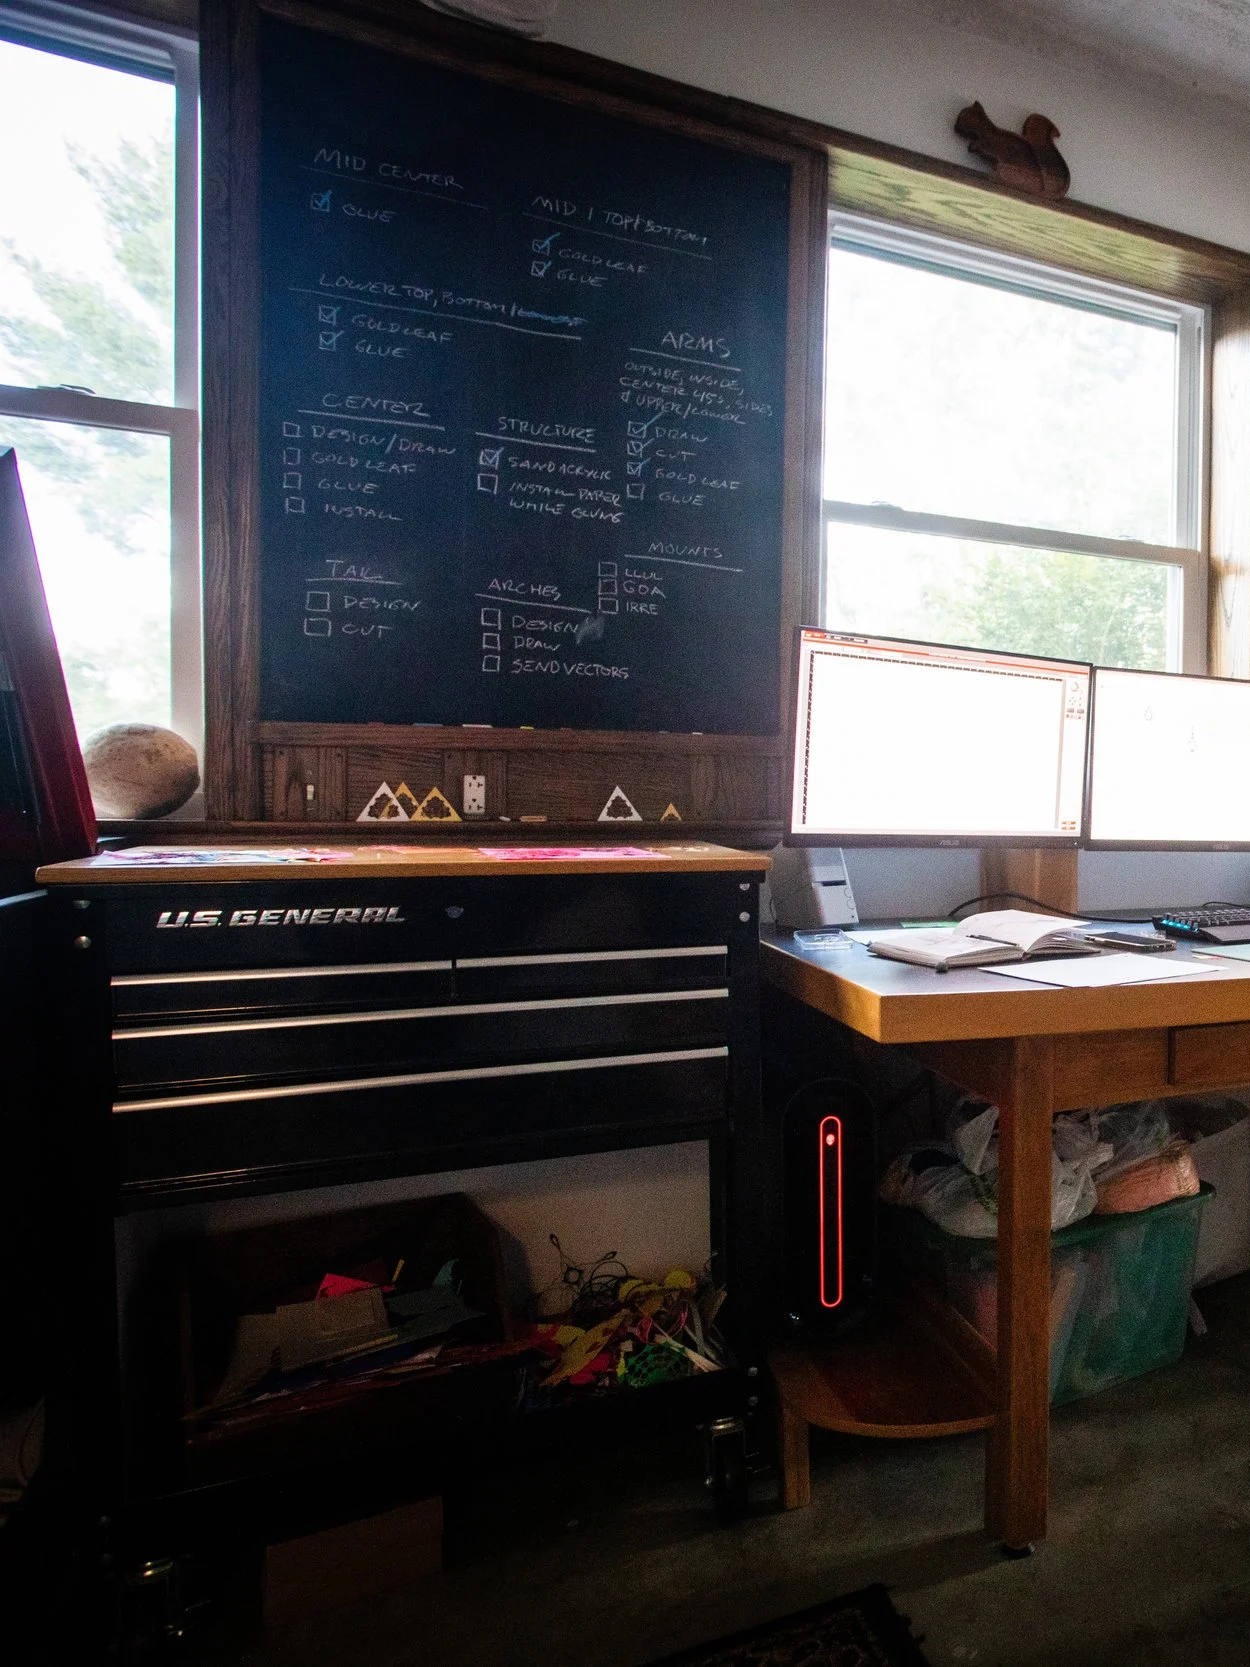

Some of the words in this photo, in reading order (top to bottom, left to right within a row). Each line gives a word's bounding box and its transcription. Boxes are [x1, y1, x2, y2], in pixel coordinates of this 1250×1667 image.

[314, 148, 366, 171] MID
[378, 163, 464, 189] CENTER
[342, 203, 398, 223] GLUE
[532, 196, 577, 216] MID
[319, 273, 401, 296] LOWER
[556, 269, 609, 287] GLUE
[355, 339, 408, 358] GLUE
[661, 331, 731, 358] ARMS
[619, 377, 687, 396] CENTER
[322, 393, 431, 417] CENTER
[498, 417, 597, 443] STRUCTURE
[655, 427, 708, 443] DRAW
[312, 452, 359, 467] GOLD
[656, 449, 697, 461] CUT
[318, 478, 379, 494] GLUE
[508, 482, 575, 497] INSTALL
[578, 488, 622, 507] PAPER
[509, 499, 565, 515] WHILE
[658, 491, 706, 506] GLUE
[325, 503, 403, 521] INSTALL
[648, 542, 723, 559] MOUNTS
[325, 559, 384, 579] TAIL
[488, 578, 562, 601] ARCHES
[344, 595, 421, 611] DESIGN
[626, 600, 659, 615] IRRE
[341, 622, 394, 638] CUT
[512, 615, 579, 634] DESIGN
[513, 635, 560, 652] DRAW
[511, 658, 561, 674] SEND
[564, 663, 630, 679] VECTORS
[156, 910, 222, 929] U.S.
[228, 905, 406, 927] GENERAL
